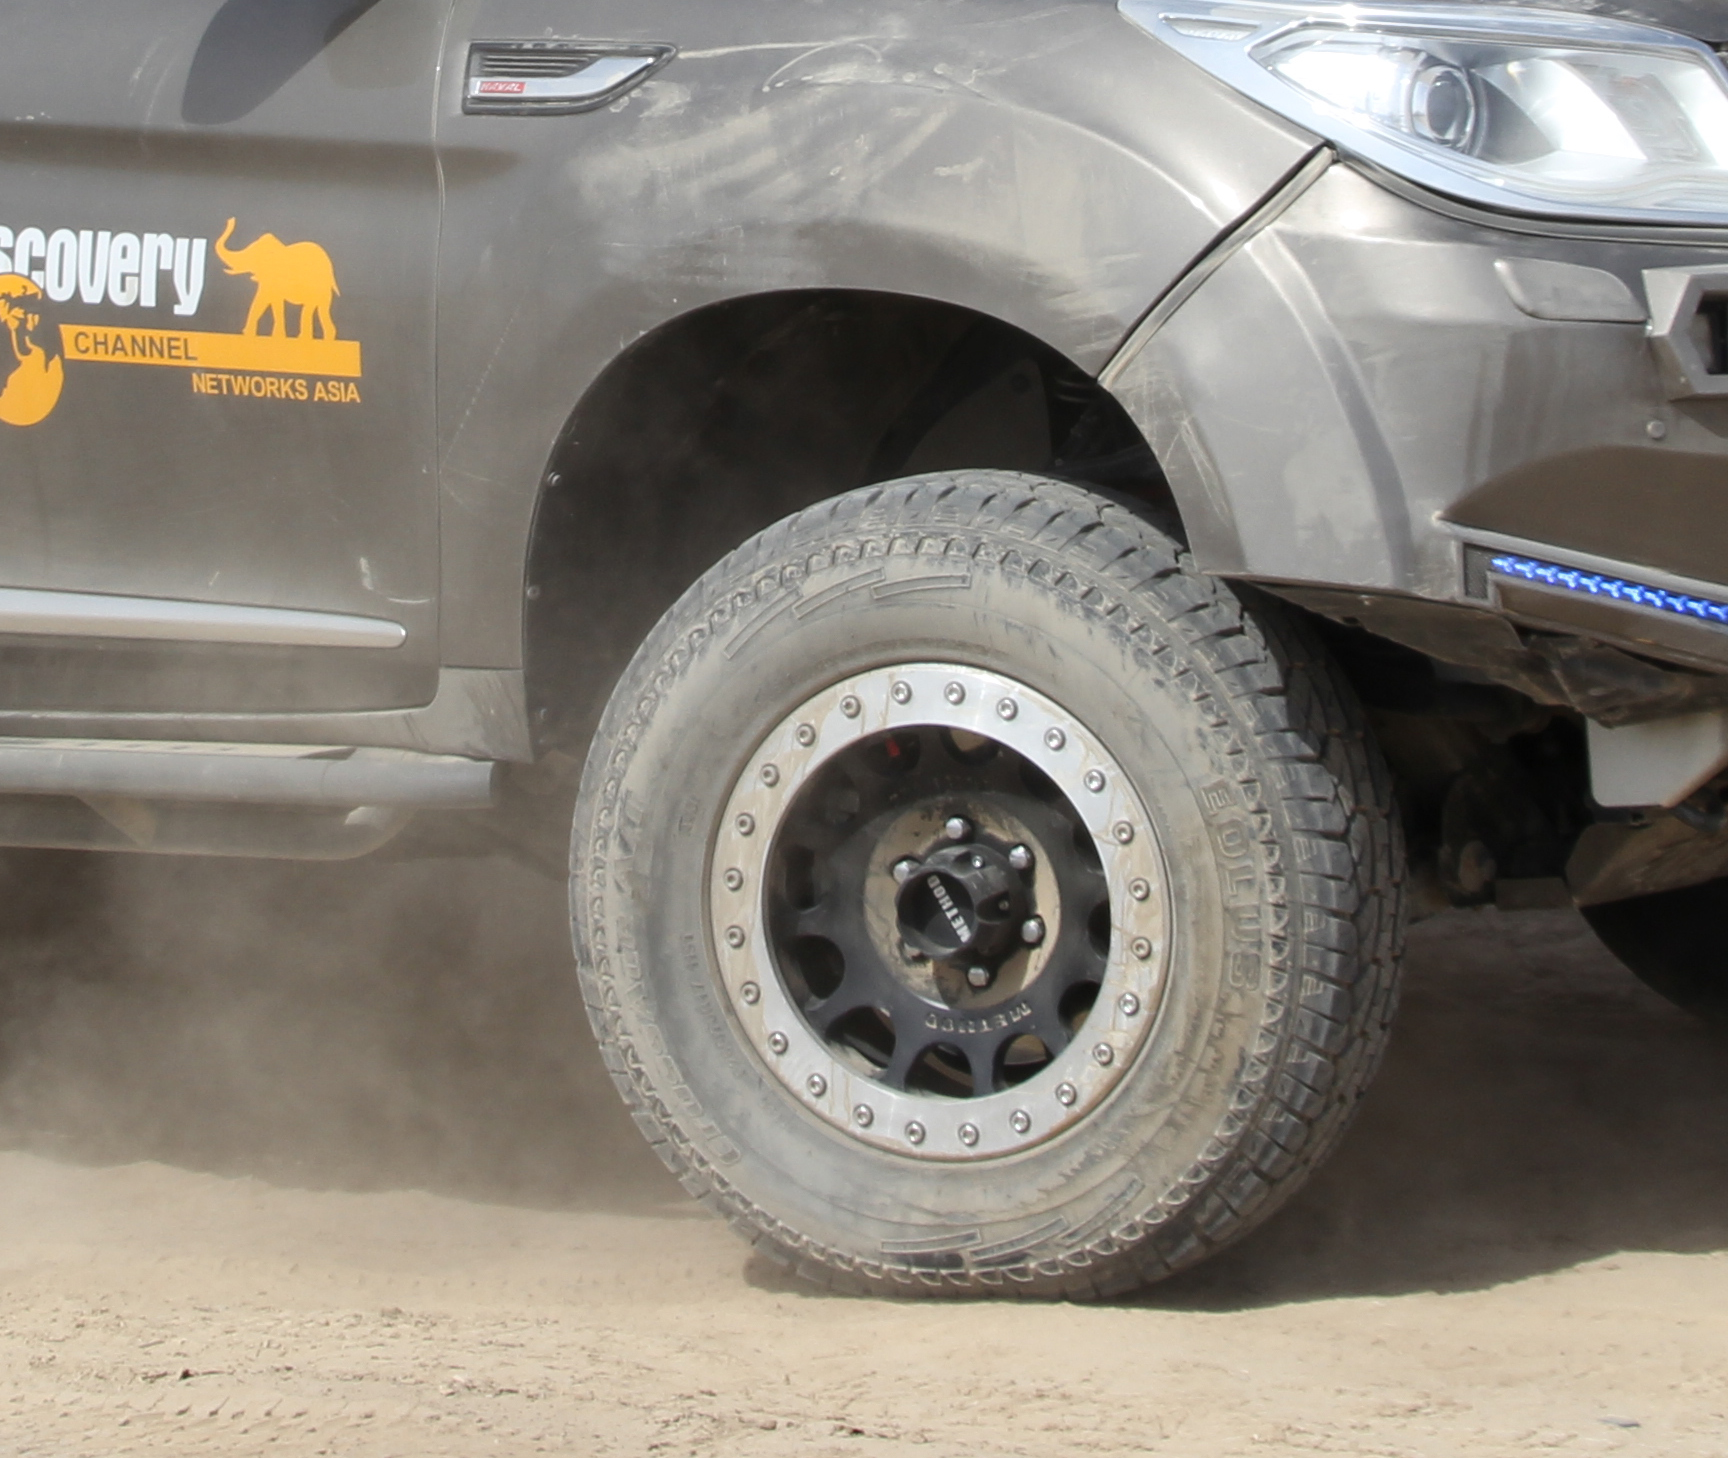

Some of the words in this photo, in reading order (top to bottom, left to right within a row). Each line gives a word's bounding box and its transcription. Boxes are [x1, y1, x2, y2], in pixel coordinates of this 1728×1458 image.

[74, 330, 199, 361] CHANNEL
[191, 372, 309, 402] NETWORKS
[313, 380, 361, 403] ASIA
[926, 874, 972, 944] METHOD
